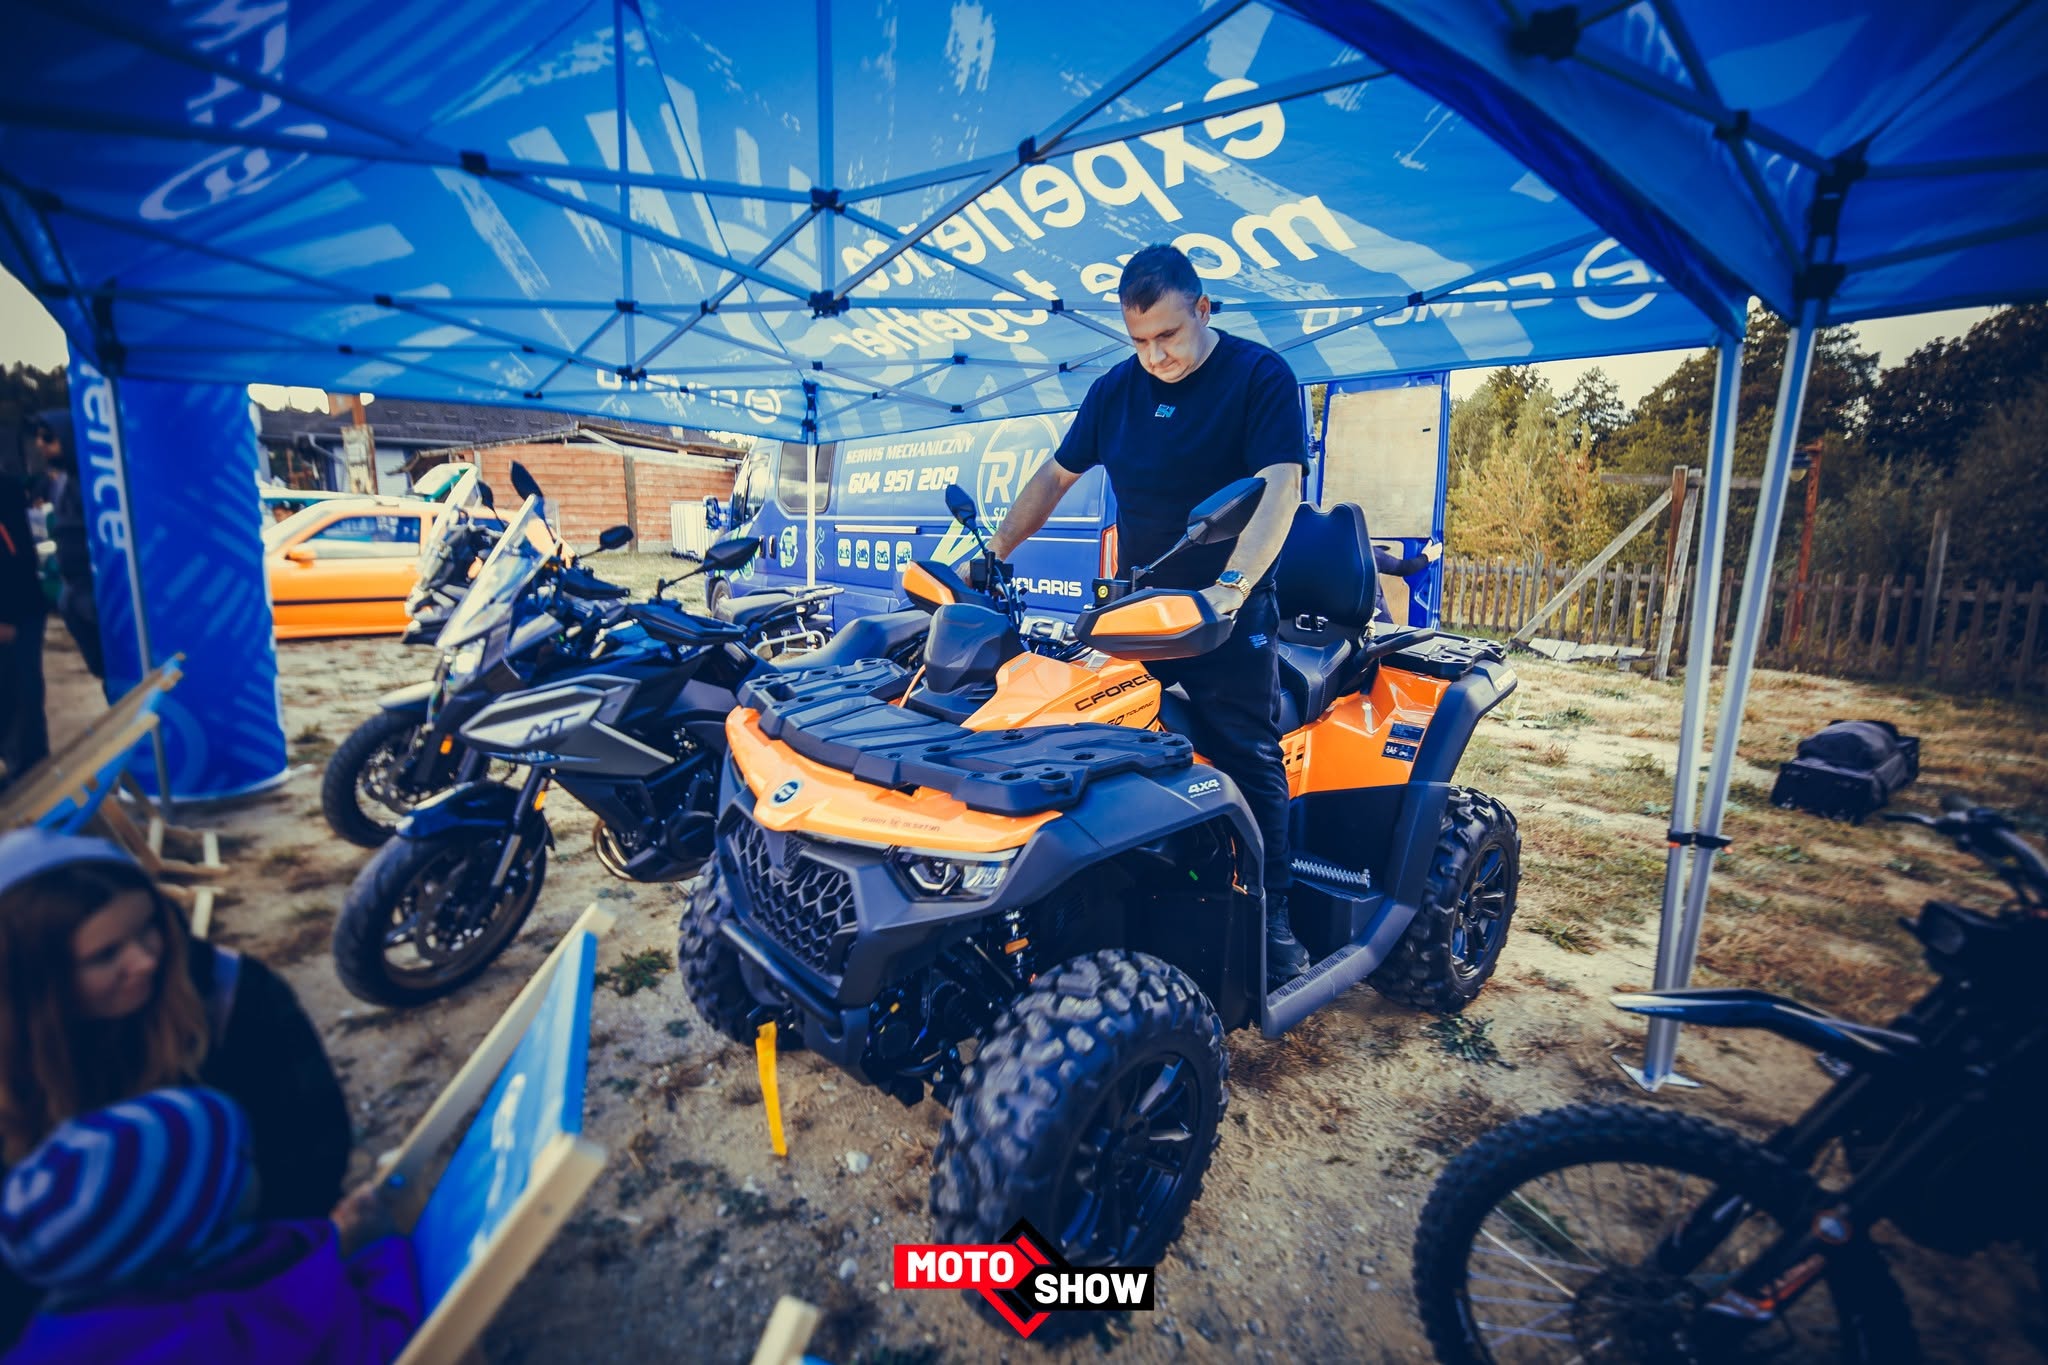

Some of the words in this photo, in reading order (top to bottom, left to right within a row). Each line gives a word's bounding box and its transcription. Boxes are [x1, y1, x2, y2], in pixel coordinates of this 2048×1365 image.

[845, 446, 884, 465] SERWIS
[886, 436, 976, 460] MECHANICZNY
[848, 471, 880, 494] 604
[883, 469, 914, 492] 951
[917, 465, 959, 491] 209
